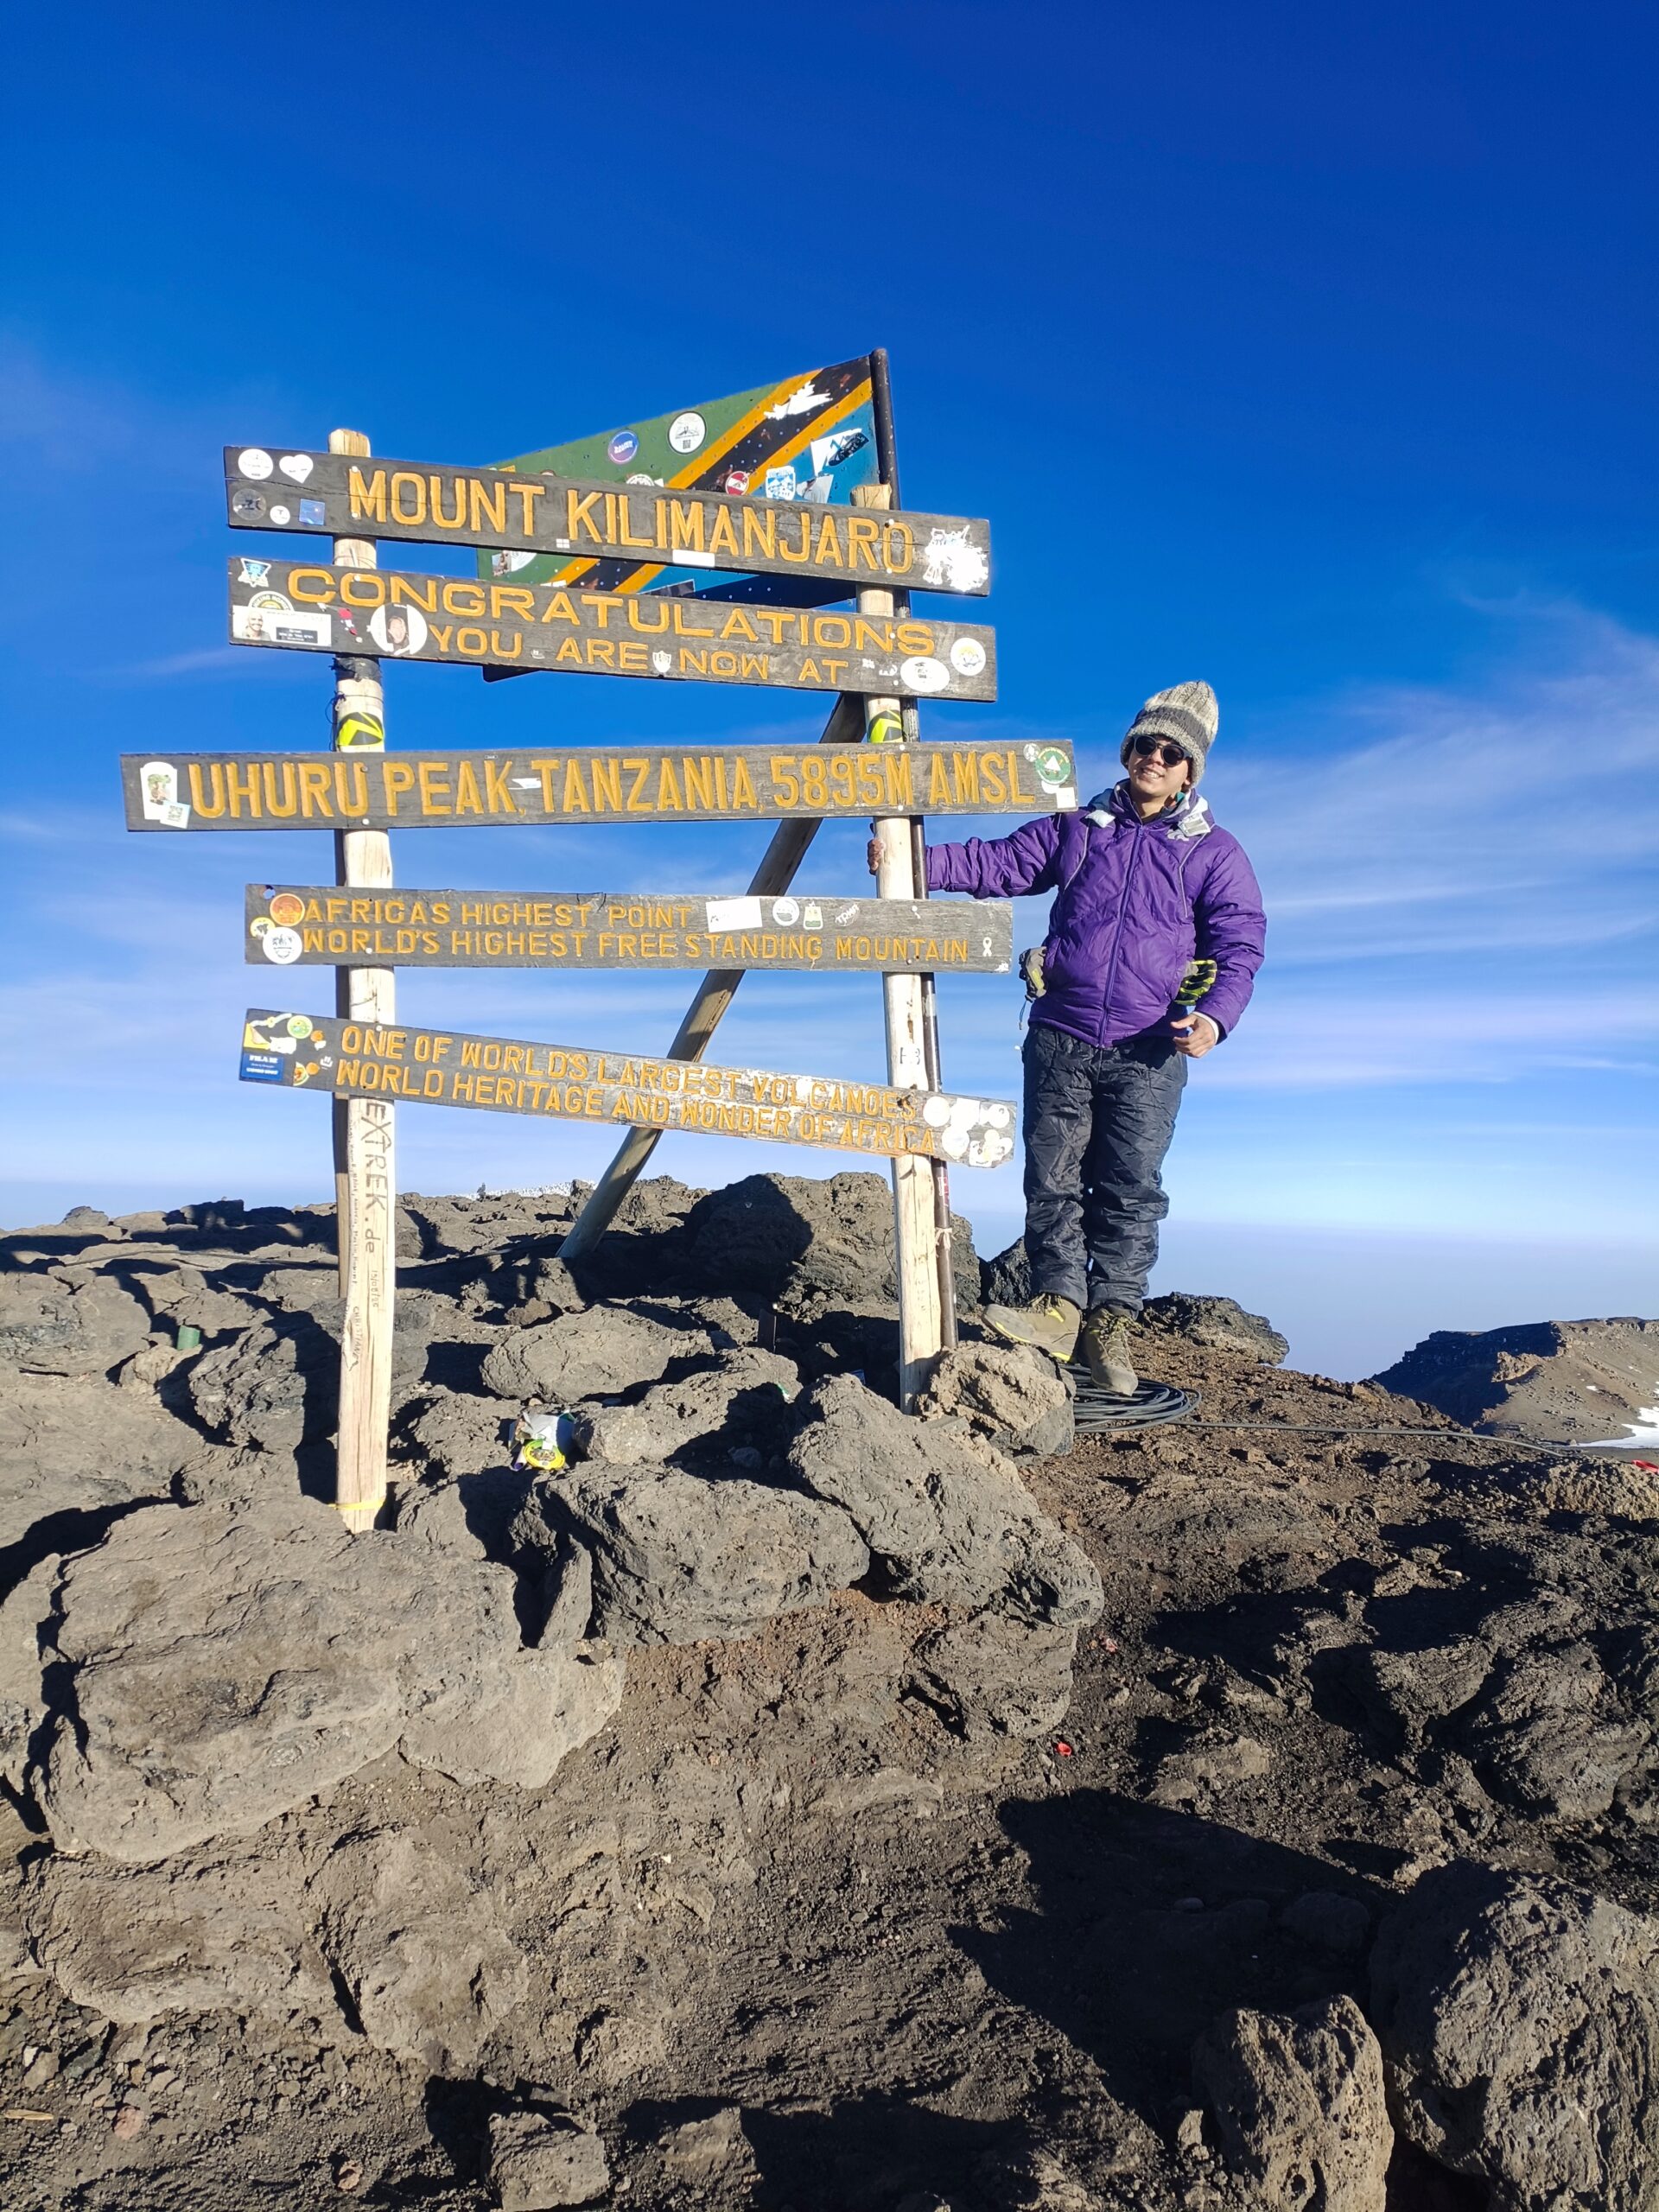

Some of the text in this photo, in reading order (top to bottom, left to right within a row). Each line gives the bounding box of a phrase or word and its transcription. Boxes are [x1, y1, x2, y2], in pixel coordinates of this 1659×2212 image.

[349, 467, 914, 574] MOUNT KILIMANJARO
[288, 569, 935, 656] CONGRATULATIONS
[429, 625, 849, 683] YOU ARE NOW AT
[188, 761, 368, 817] UHURU
[383, 760, 525, 816] PEAK,
[770, 753, 913, 808] 5895M
[929, 750, 1034, 804] AMSL
[303, 928, 440, 954] WORLD'S
[452, 931, 587, 957] HIGHEST
[836, 938, 969, 962] MOUNTAIN
[461, 903, 591, 927] HIGHEST
[607, 905, 692, 928] POINT
[336, 1059, 934, 1154] WORLD HERITAGE AND WONDER OF AFRICA
[341, 1026, 405, 1059] ONE
[414, 1036, 452, 1063] OF
[597, 1057, 742, 1101] LARGEST
[753, 1077, 917, 1121] VOLCANOES
